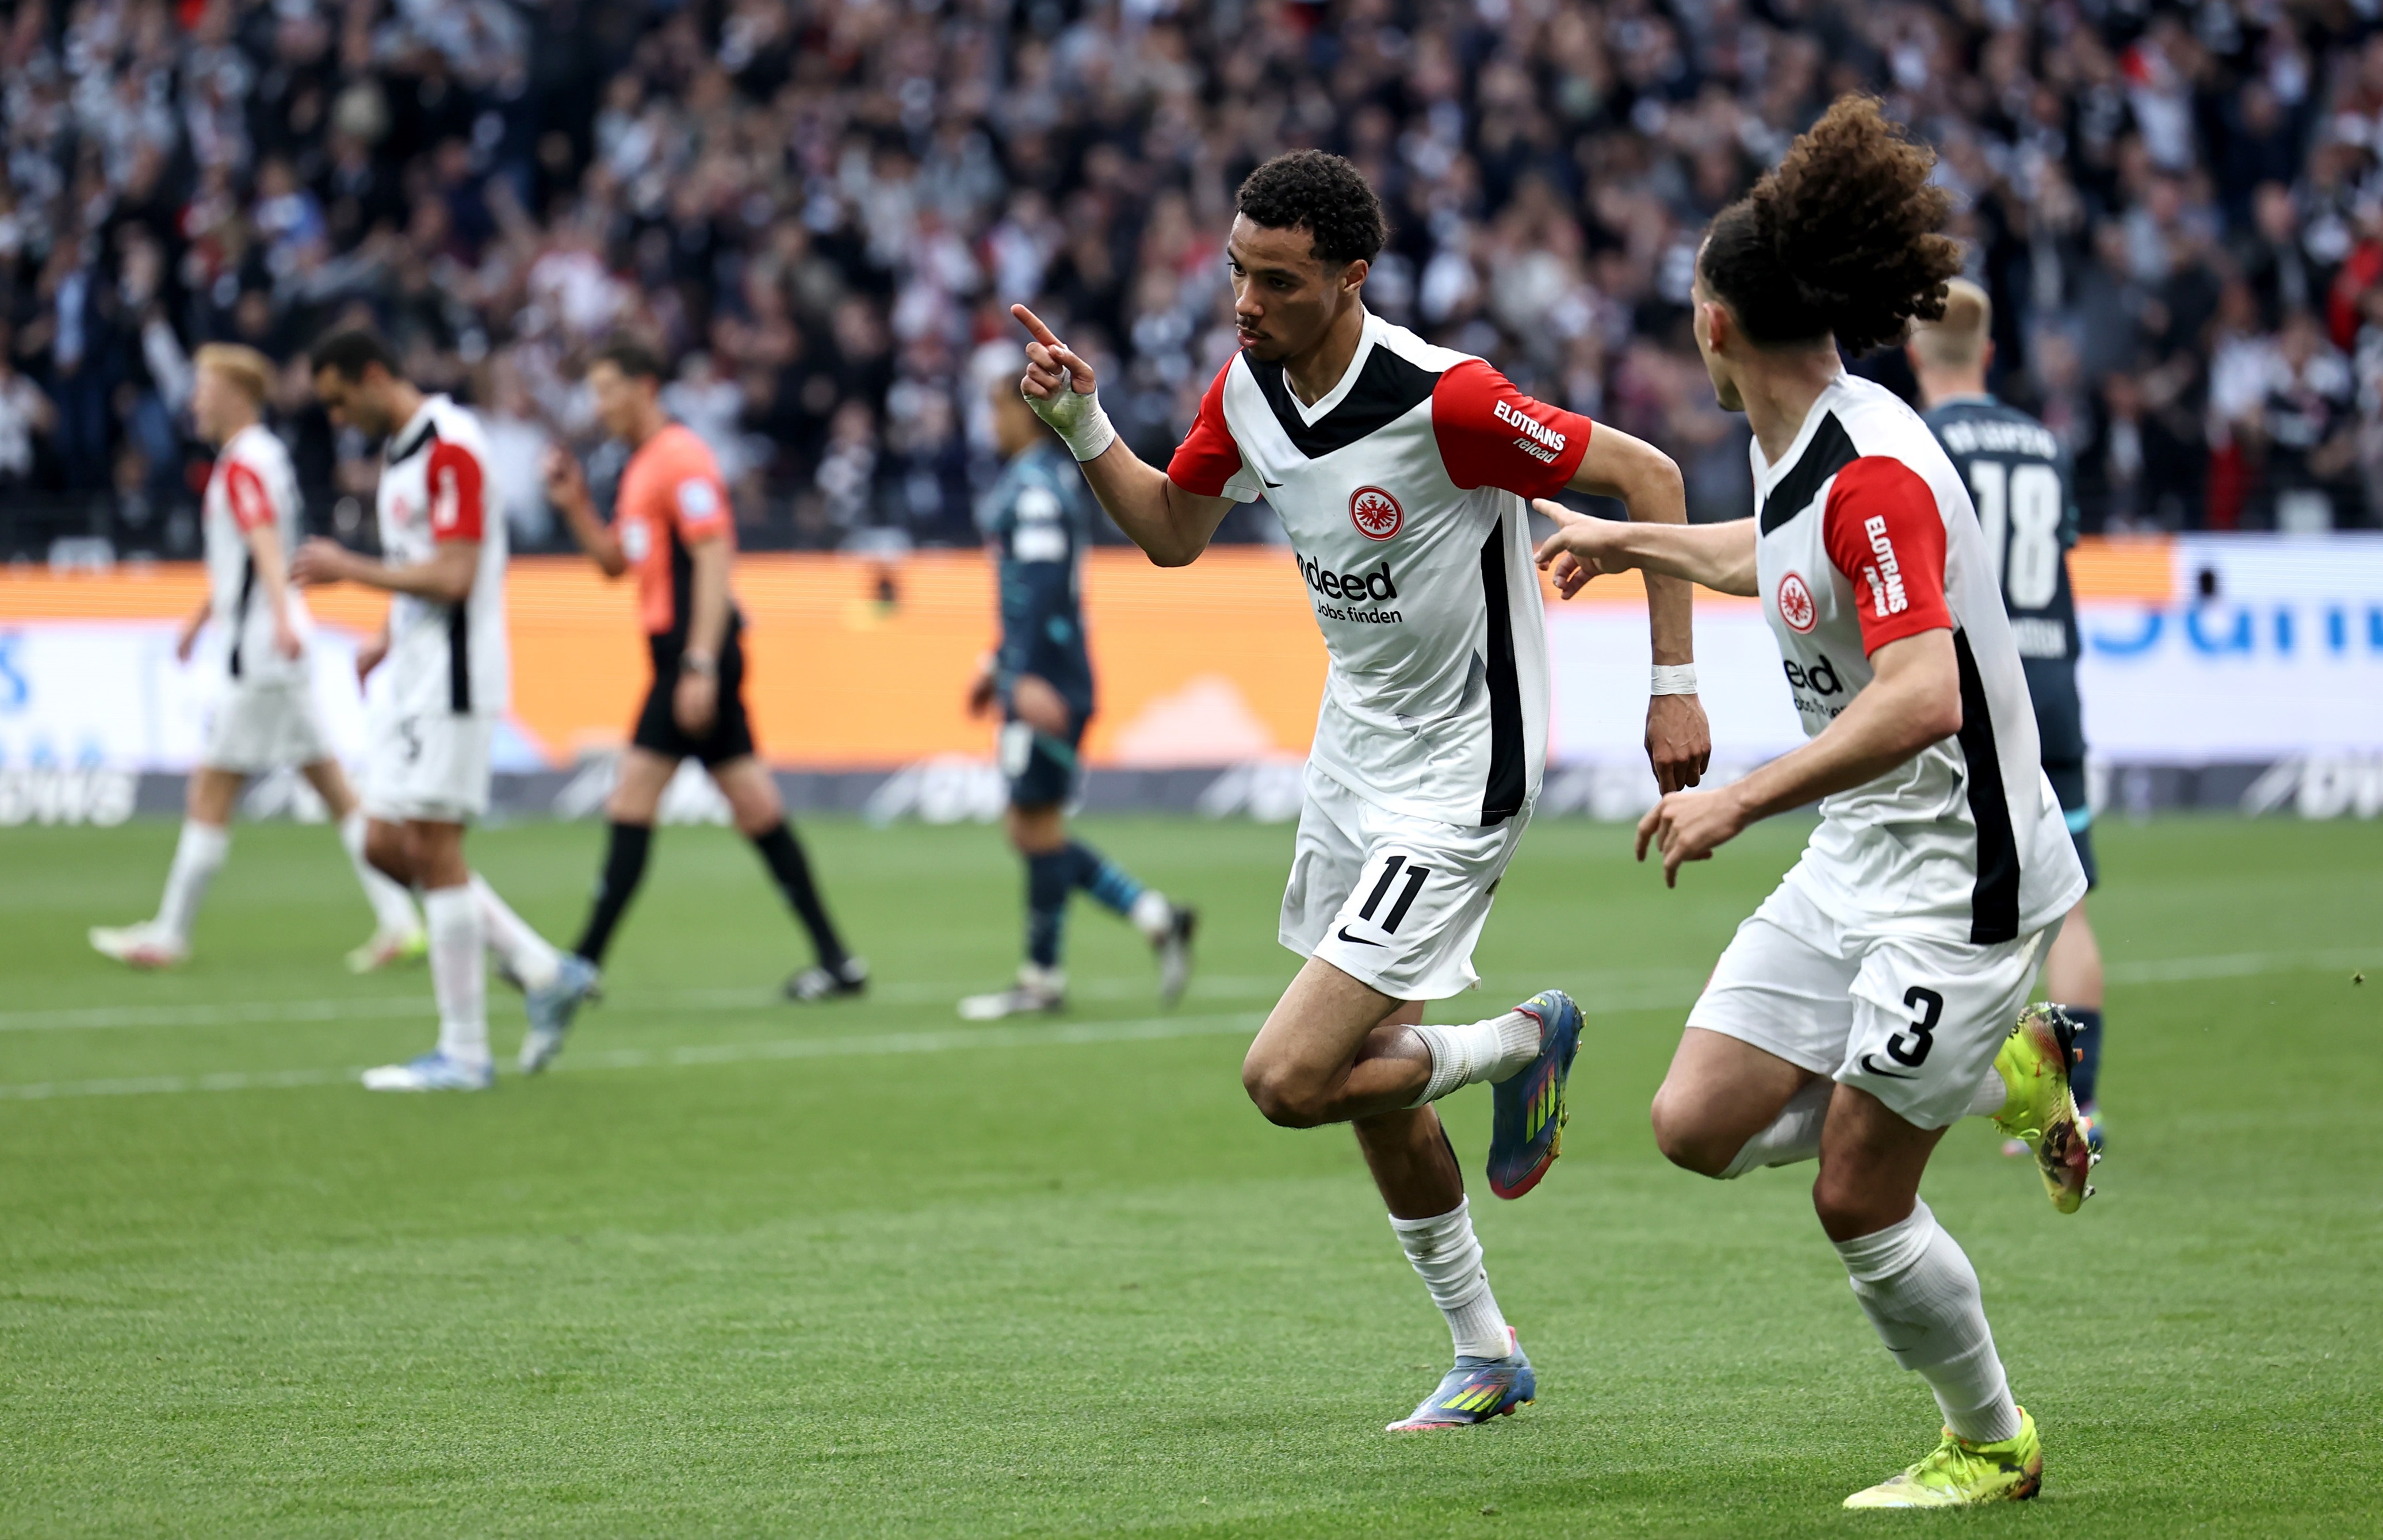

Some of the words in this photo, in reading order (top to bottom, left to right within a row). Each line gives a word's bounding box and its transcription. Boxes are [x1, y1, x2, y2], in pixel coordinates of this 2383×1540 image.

[1493, 399, 1566, 451] ELOTRANS
[1513, 438, 1559, 463] reload
[1864, 515, 1908, 614] ELOTRANS
[1969, 459, 2062, 610] 18
[1317, 599, 1346, 620] Jobs
[1347, 606, 1403, 623] finden
[1359, 855, 1430, 934] 11
[1887, 986, 1944, 1067] 3
